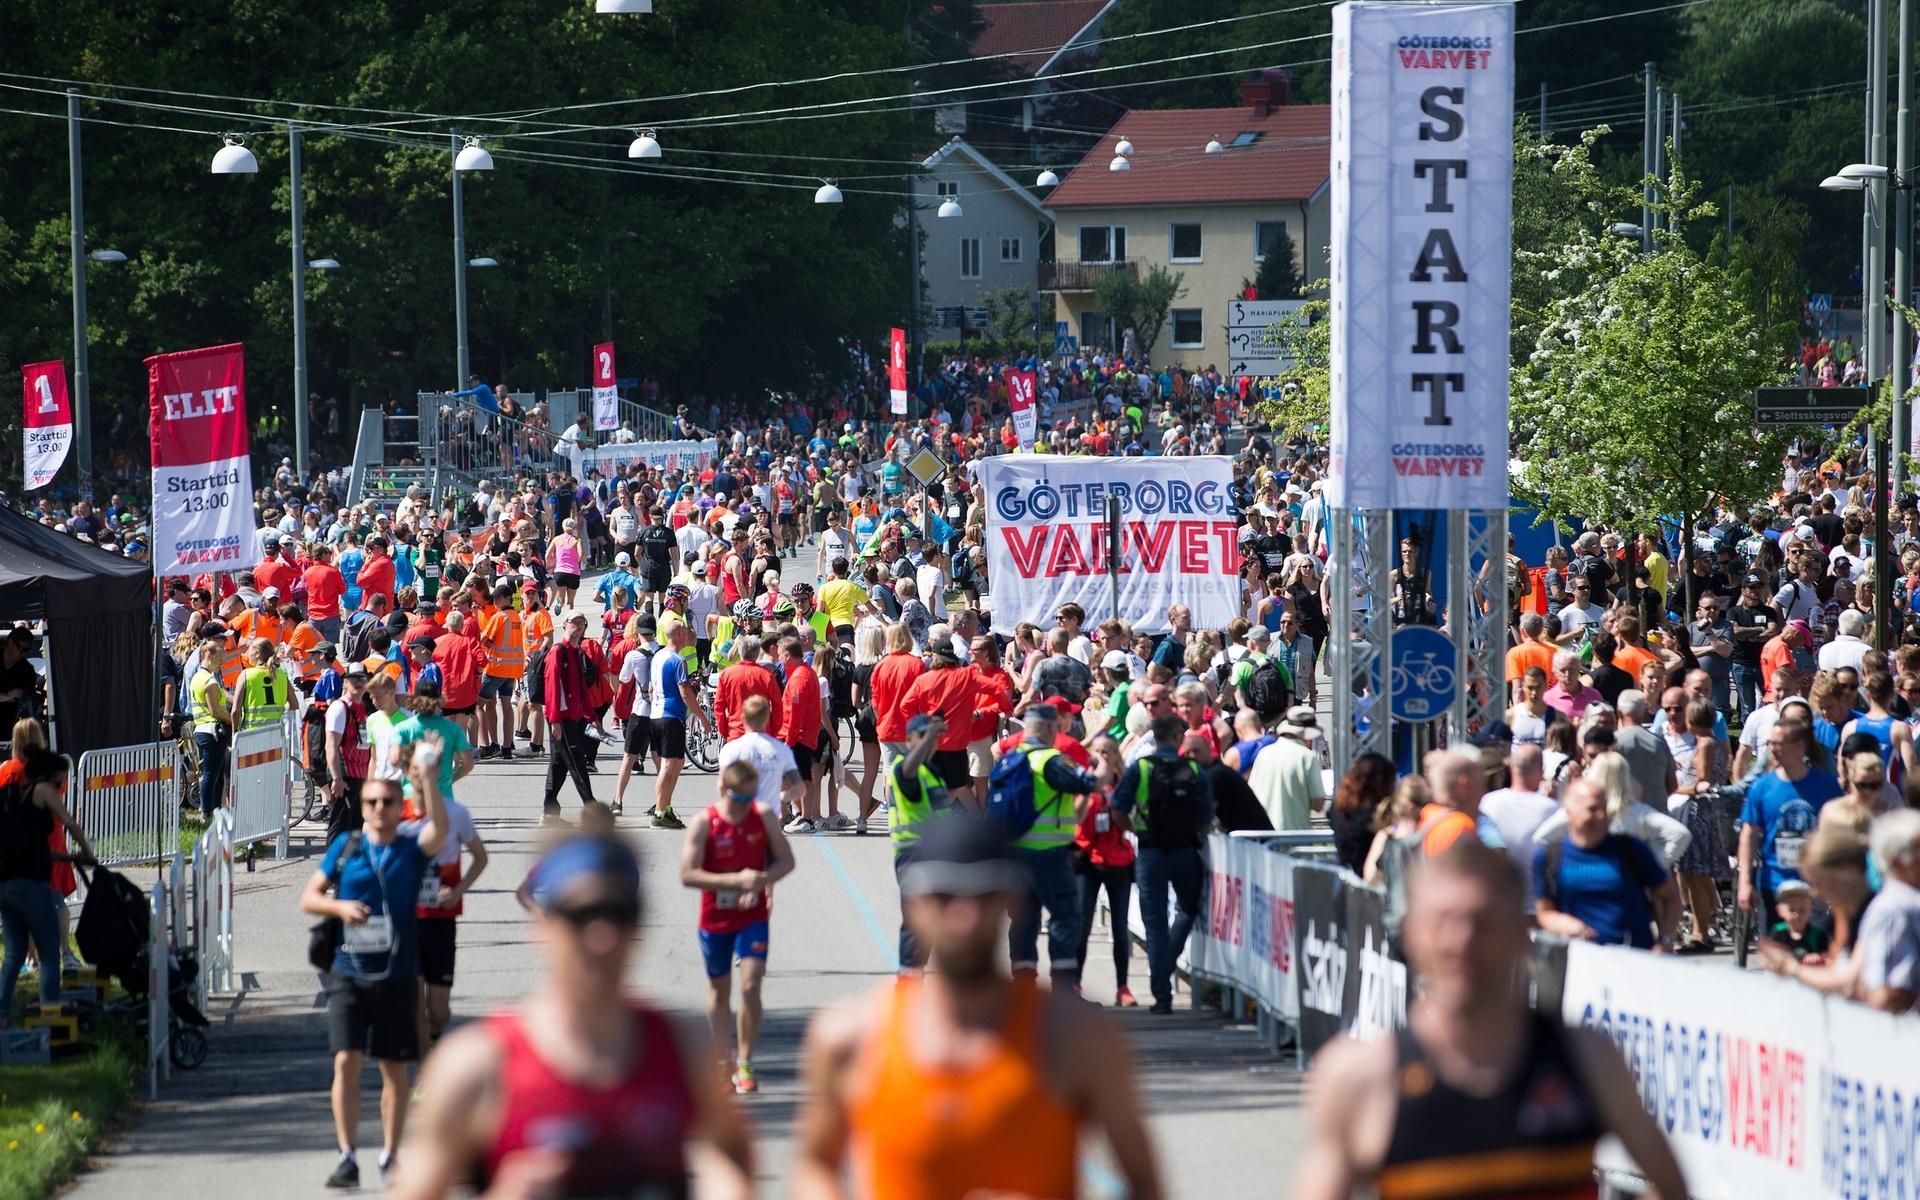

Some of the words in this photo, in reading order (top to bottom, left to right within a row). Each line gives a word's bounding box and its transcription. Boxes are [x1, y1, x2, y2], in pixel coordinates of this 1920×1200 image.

[1398, 34, 1492, 49] GÖTEBORGS
[1399, 50, 1492, 70] VARVET
[1409, 85, 1468, 426] START
[599, 351, 611, 380] 2
[34, 374, 59, 414] 1
[163, 385, 238, 421] ELIT
[29, 429, 68, 443] Starttid
[1392, 442, 1485, 456] GÖTEBORGS
[1392, 457, 1485, 476] VARVET
[167, 468, 240, 493] Starttid
[182, 491, 229, 513] 13:00
[175, 534, 240, 551] GÖTEBORGS
[177, 545, 240, 565] VARVET
